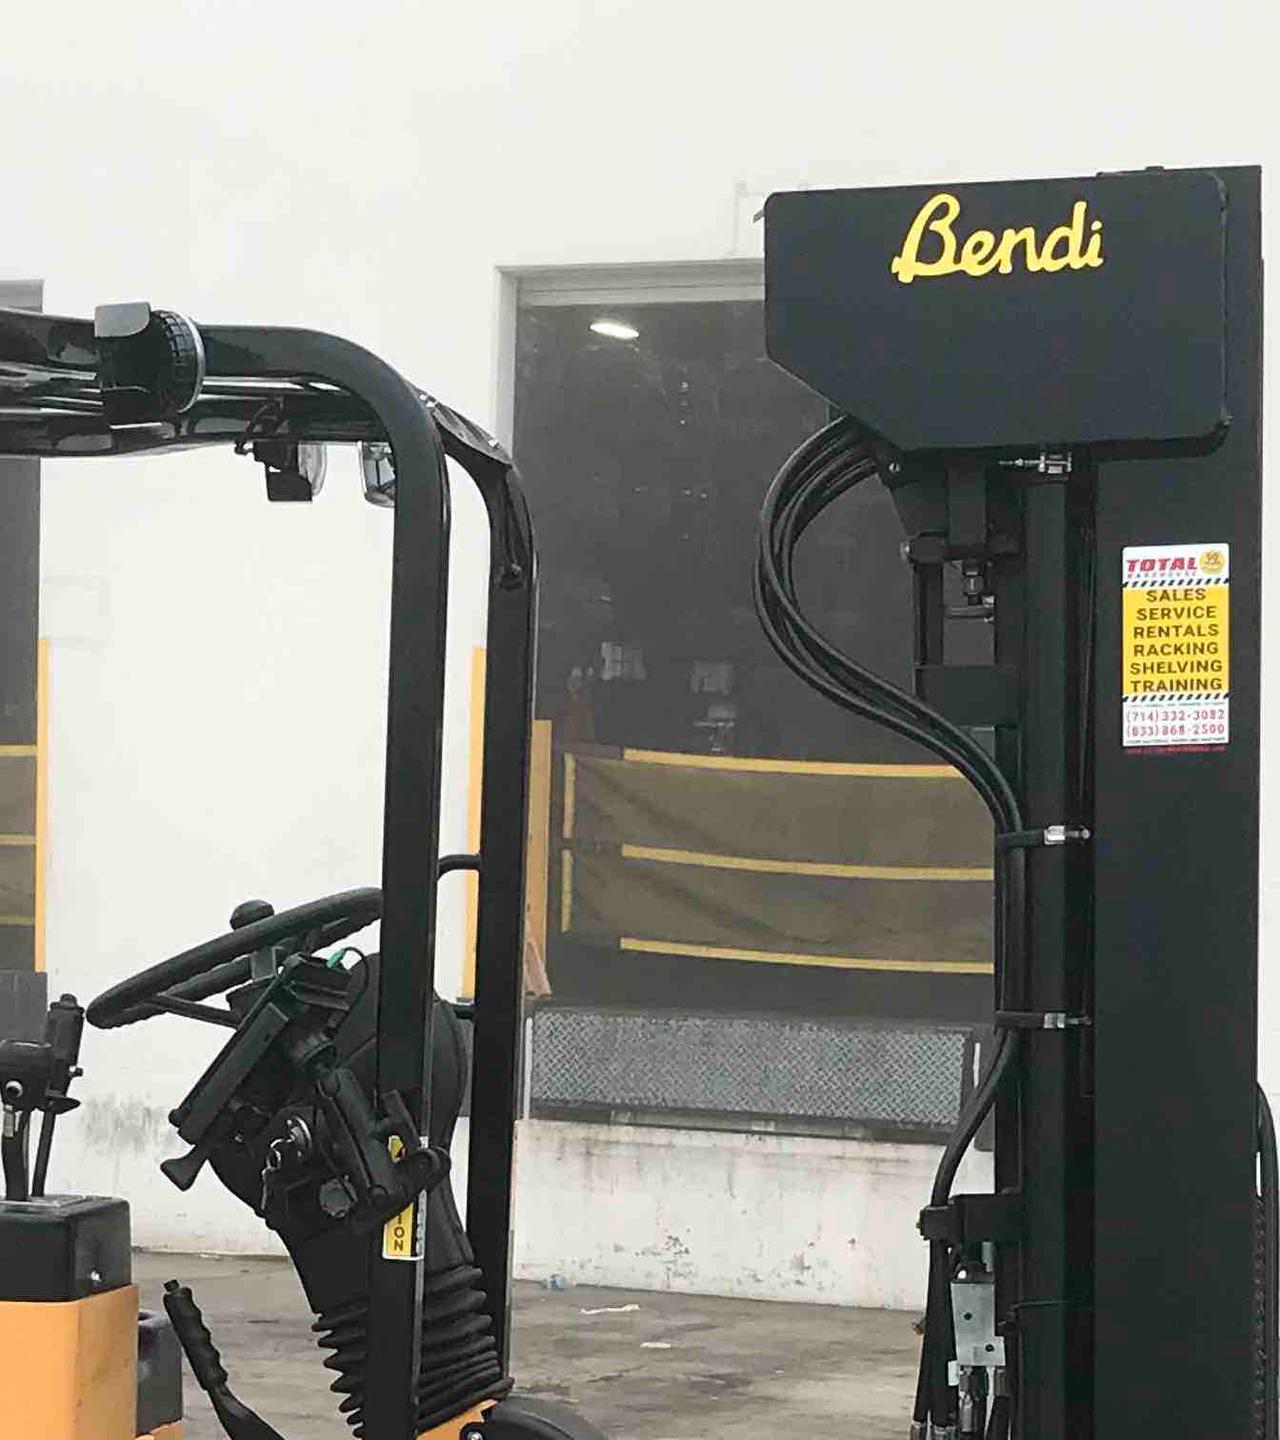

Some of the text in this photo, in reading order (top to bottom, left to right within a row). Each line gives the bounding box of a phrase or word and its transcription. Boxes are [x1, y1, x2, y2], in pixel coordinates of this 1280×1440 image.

[891, 193, 1104, 284] Bendi
[1126, 557, 1198, 573] TOTAL
[1145, 588, 1207, 603] SALES
[1136, 605, 1218, 621] SERVICE
[1133, 623, 1220, 639] RENTALS
[1133, 641, 1219, 657] RACKING
[1130, 660, 1223, 676] SHELVING
[1130, 678, 1223, 693] TRAINING
